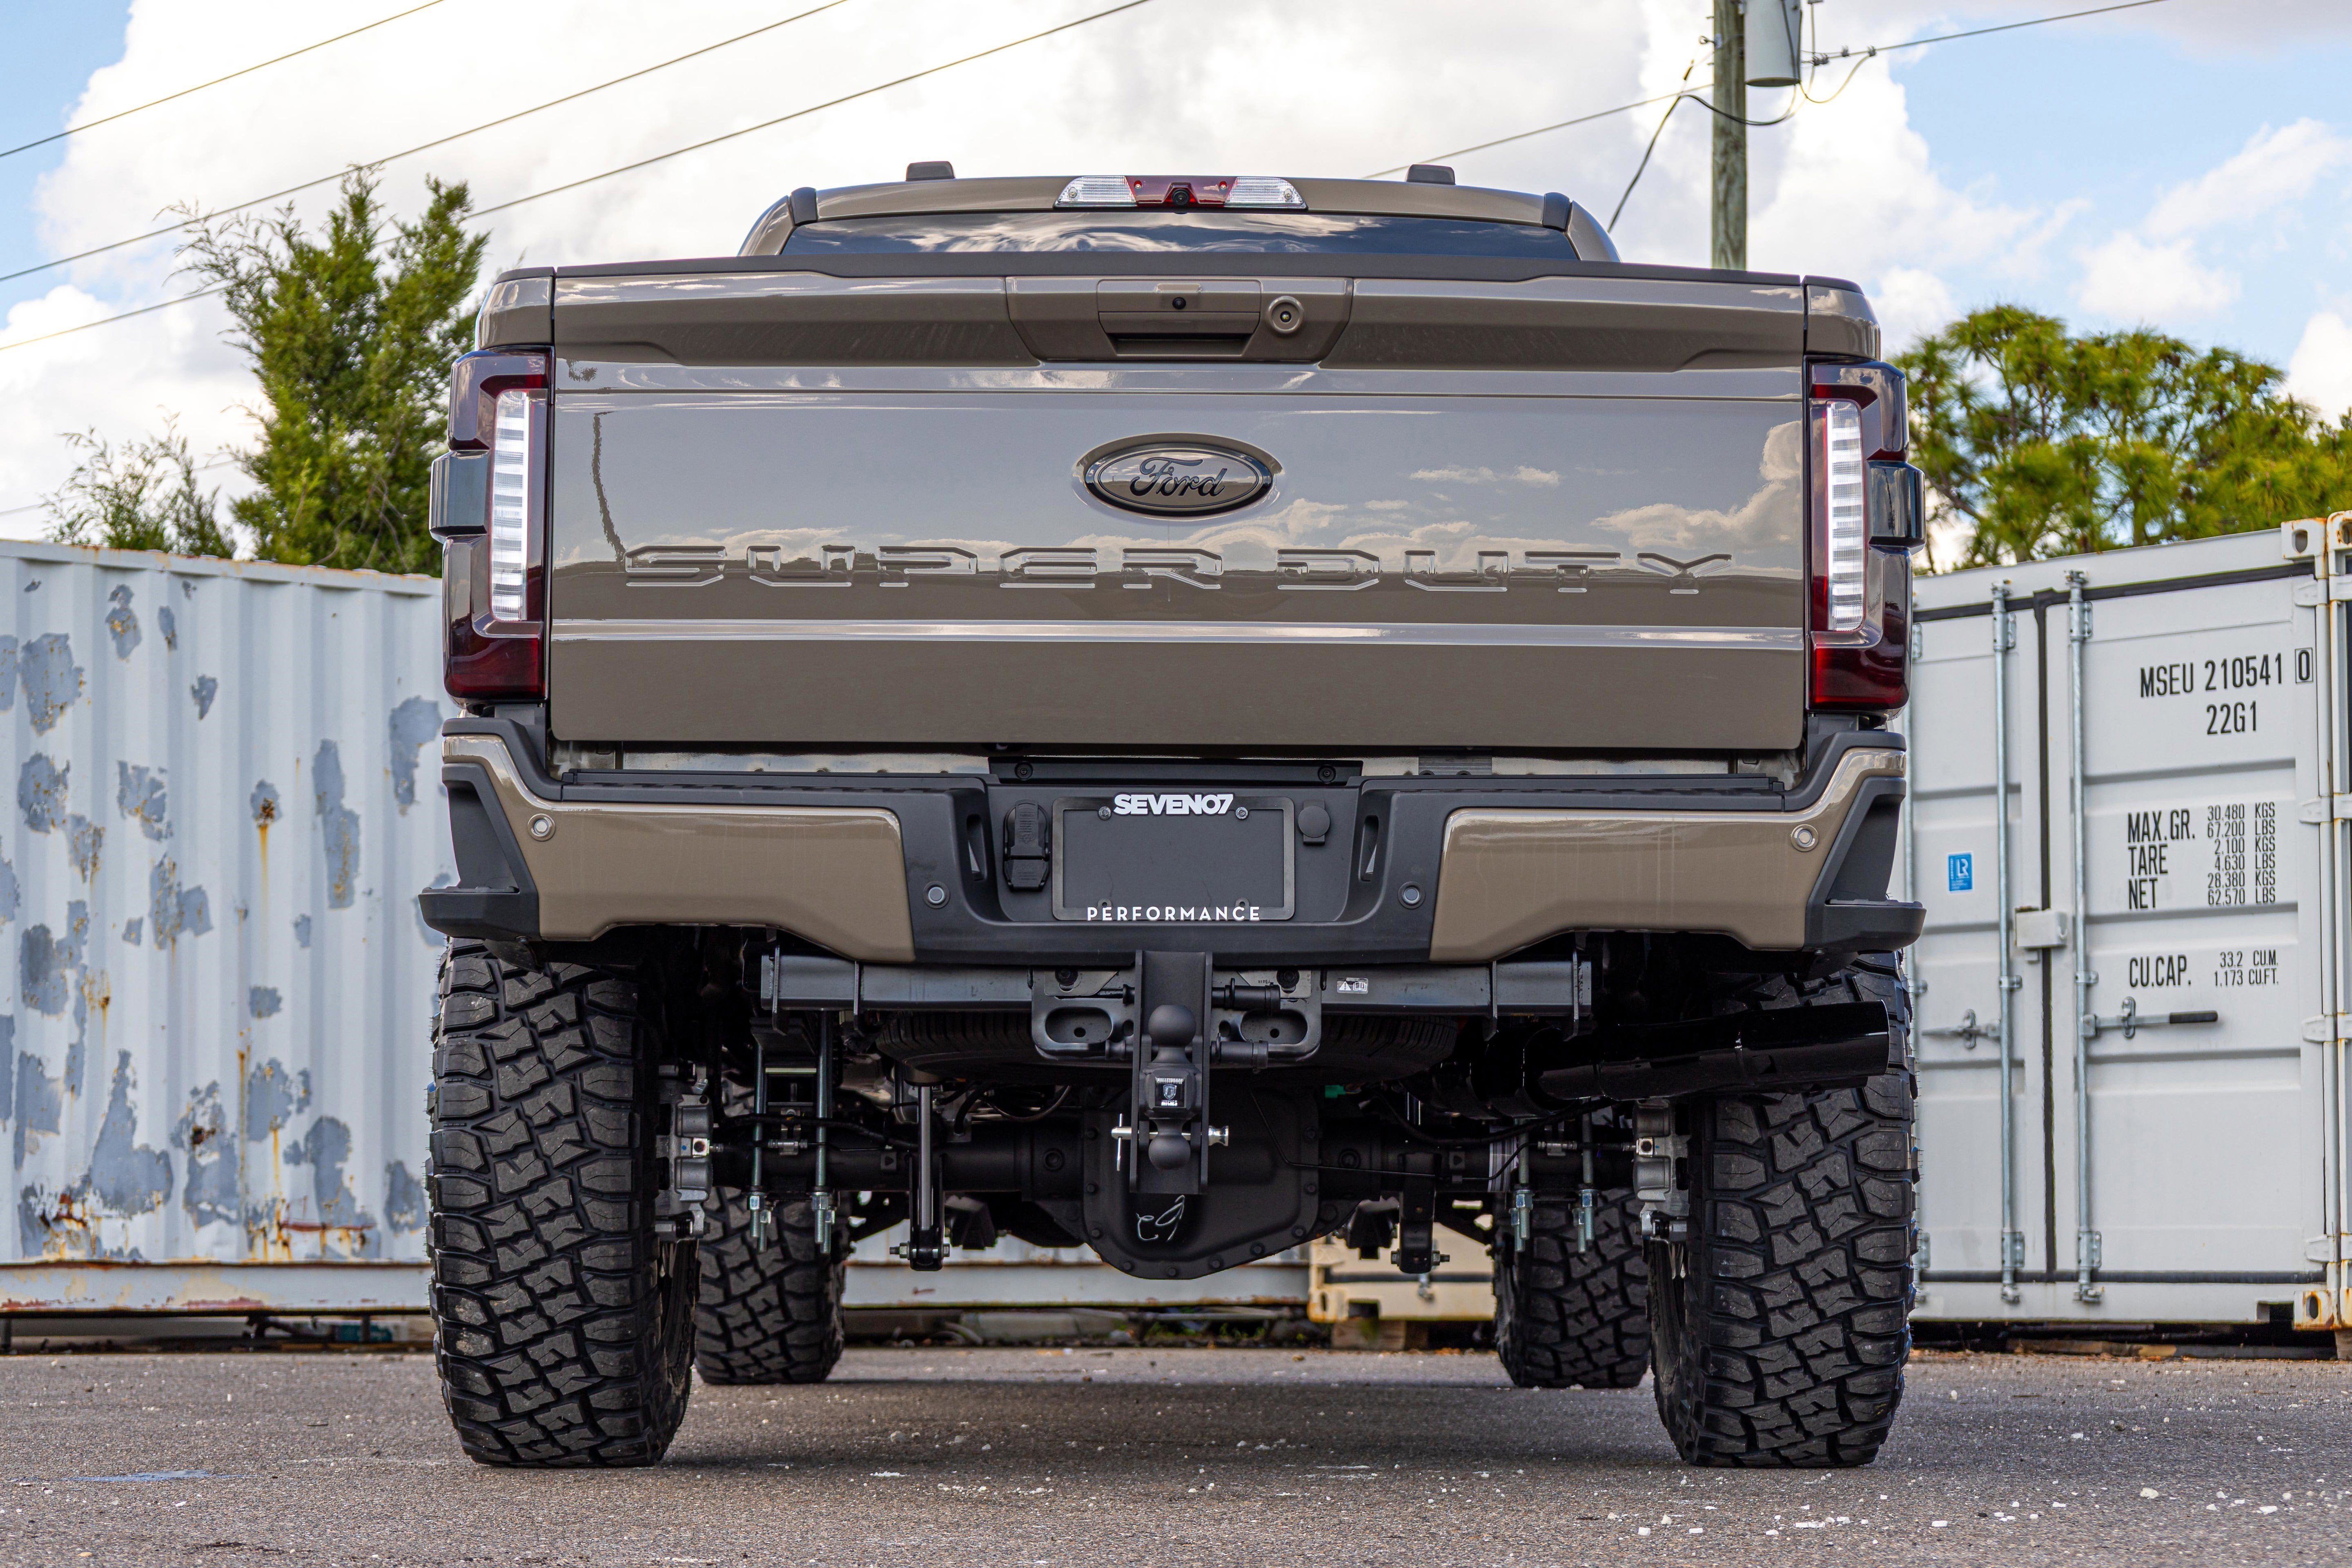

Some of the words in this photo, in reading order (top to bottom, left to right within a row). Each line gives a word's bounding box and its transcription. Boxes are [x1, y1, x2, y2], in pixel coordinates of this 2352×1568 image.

[1129, 457, 1227, 497] Ford
[625, 545, 1223, 589] SUPER
[1276, 549, 1733, 594] DUTY
[2140, 662, 2194, 697] MSEU
[2205, 653, 2282, 691] 210541
[2298, 650, 2310, 681] 0
[2207, 701, 2257, 735] 22G1
[2255, 802, 2275, 818] KGS
[2255, 819, 2275, 835] LBS
[2128, 844, 2168, 876] TARE
[2255, 835, 2275, 852] KGS
[2255, 853, 2275, 869] LBS
[2129, 877, 2158, 909] NET
[2255, 869, 2275, 886] KGS
[2256, 886, 2276, 903] LBS
[1087, 906, 1261, 921] PERFORMANCE
[2220, 951, 2243, 967] 33.2
